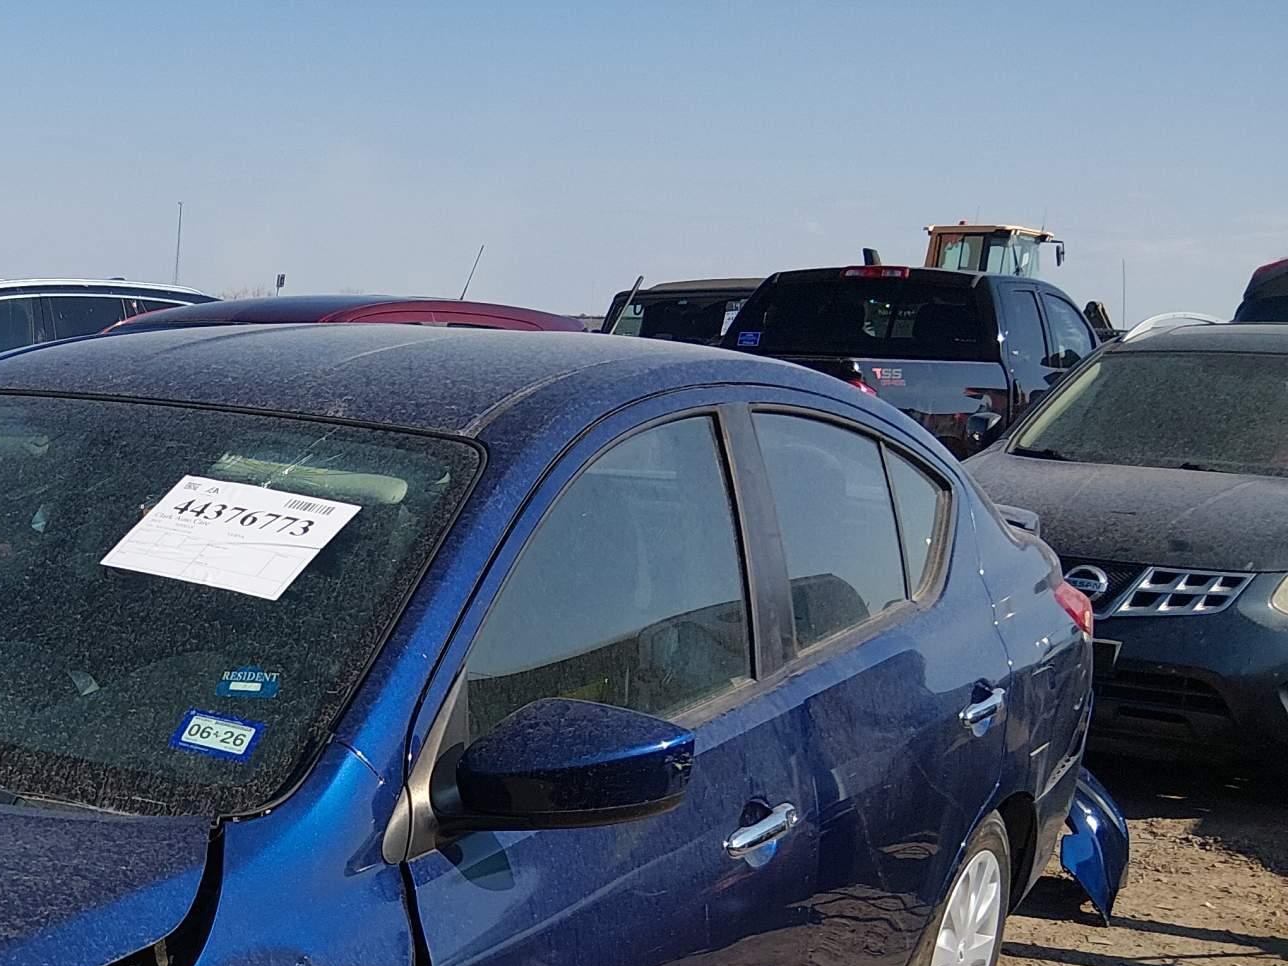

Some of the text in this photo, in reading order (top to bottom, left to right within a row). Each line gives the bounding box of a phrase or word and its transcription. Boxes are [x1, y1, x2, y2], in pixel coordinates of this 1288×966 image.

[174, 498, 315, 536] 44376773
[222, 671, 280, 682] RESIDENT
[187, 723, 213, 739] 06
[220, 731, 247, 747] 26
